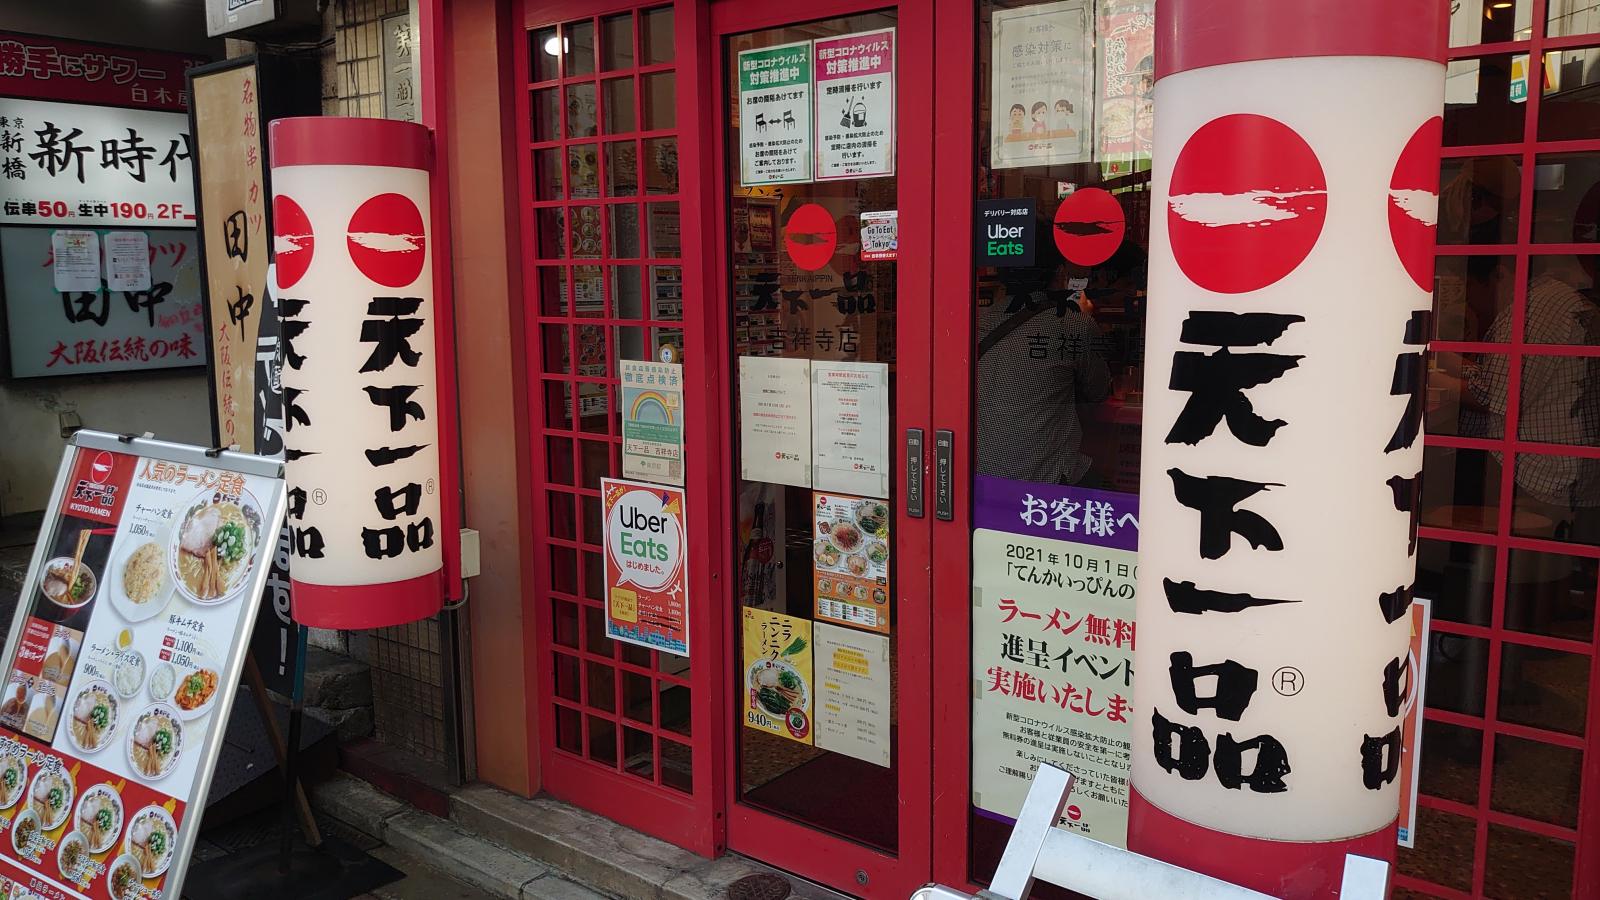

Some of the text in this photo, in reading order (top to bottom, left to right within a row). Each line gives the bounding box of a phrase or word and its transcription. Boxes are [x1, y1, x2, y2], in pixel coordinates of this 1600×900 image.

[1012, 40, 1072, 58] 感染対策に
[750, 66, 800, 86] 対策推進中
[826, 54, 882, 75] 対策推進中
[0, 130, 27, 181] 新橋
[984, 208, 1029, 217] デリバリー対応店
[883, 225, 893, 234] Eat
[987, 224, 1024, 239] Uber
[871, 240, 890, 249] Tokyo
[987, 241, 1024, 256] Eats
[223, 210, 255, 342] 田中
[748, 271, 876, 315] 天下一品
[46, 332, 198, 368] 大阪伝統の味
[768, 327, 859, 353] 吉祥寺店
[624, 371, 678, 387] 徹底点検済
[359, 296, 434, 560] 天下一品
[139, 459, 245, 496] 人気のラーメン定食
[70, 502, 112, 517] KYOTO RAMEN
[619, 504, 668, 534] Uber
[1019, 493, 1139, 537] お客様へ
[620, 531, 669, 562] Eats
[1152, 310, 1306, 793] 天下一品
[626, 559, 664, 576] はじめました。
[998, 597, 1137, 652] ラーメン無料
[1000, 632, 1135, 687] 進呈イベント
[986, 666, 1134, 724] 実施いたしま
[1058, 816, 1091, 834] 天下一品
